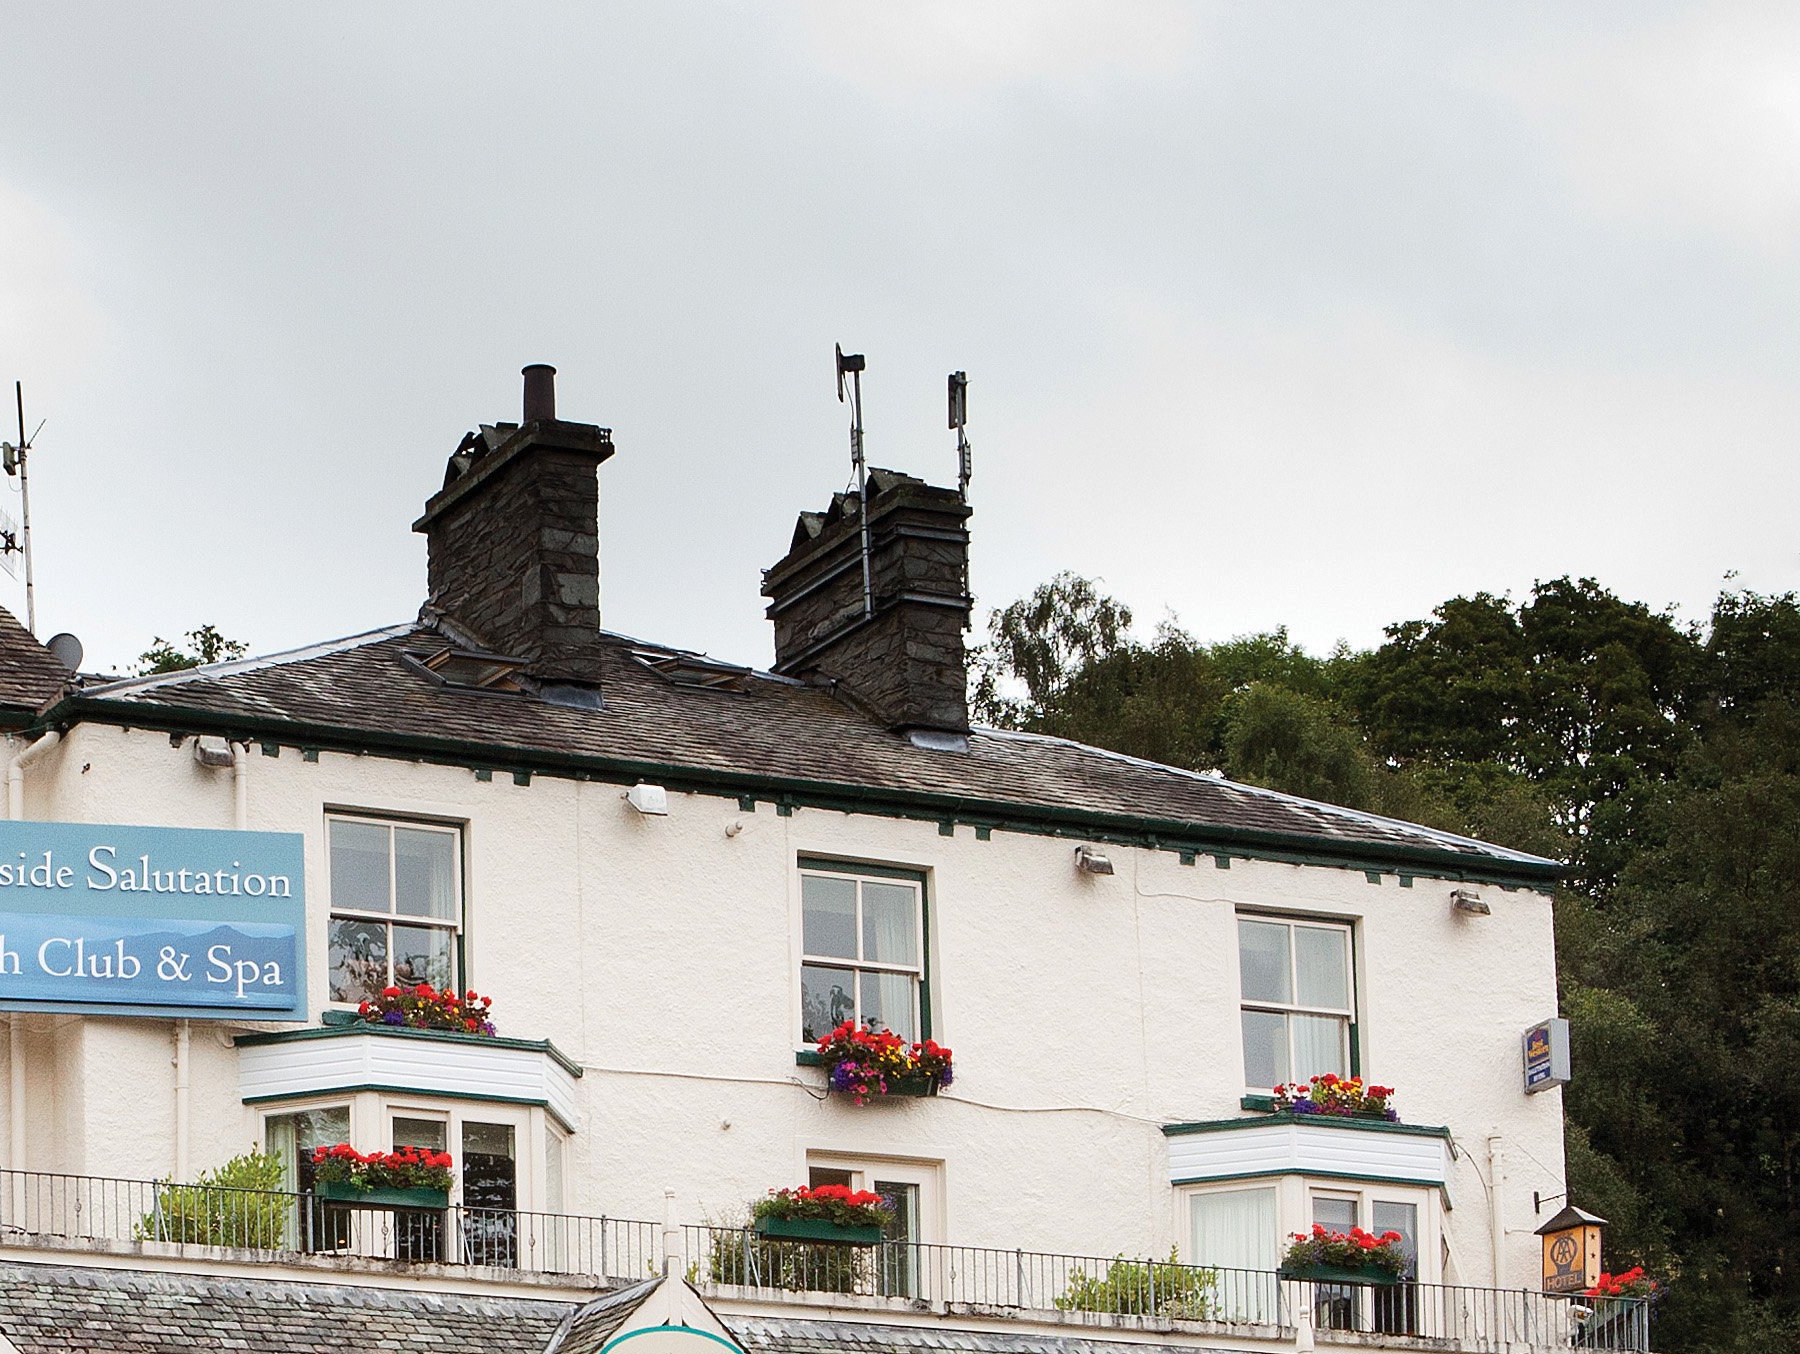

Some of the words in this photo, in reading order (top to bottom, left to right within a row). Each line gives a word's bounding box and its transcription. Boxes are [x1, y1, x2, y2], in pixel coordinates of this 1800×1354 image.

[87, 846, 292, 898] Salutation
[38, 937, 142, 981] Club
[157, 945, 192, 983] &
[206, 944, 284, 998] Spa
[1546, 1272, 1582, 1290] HOTEL
